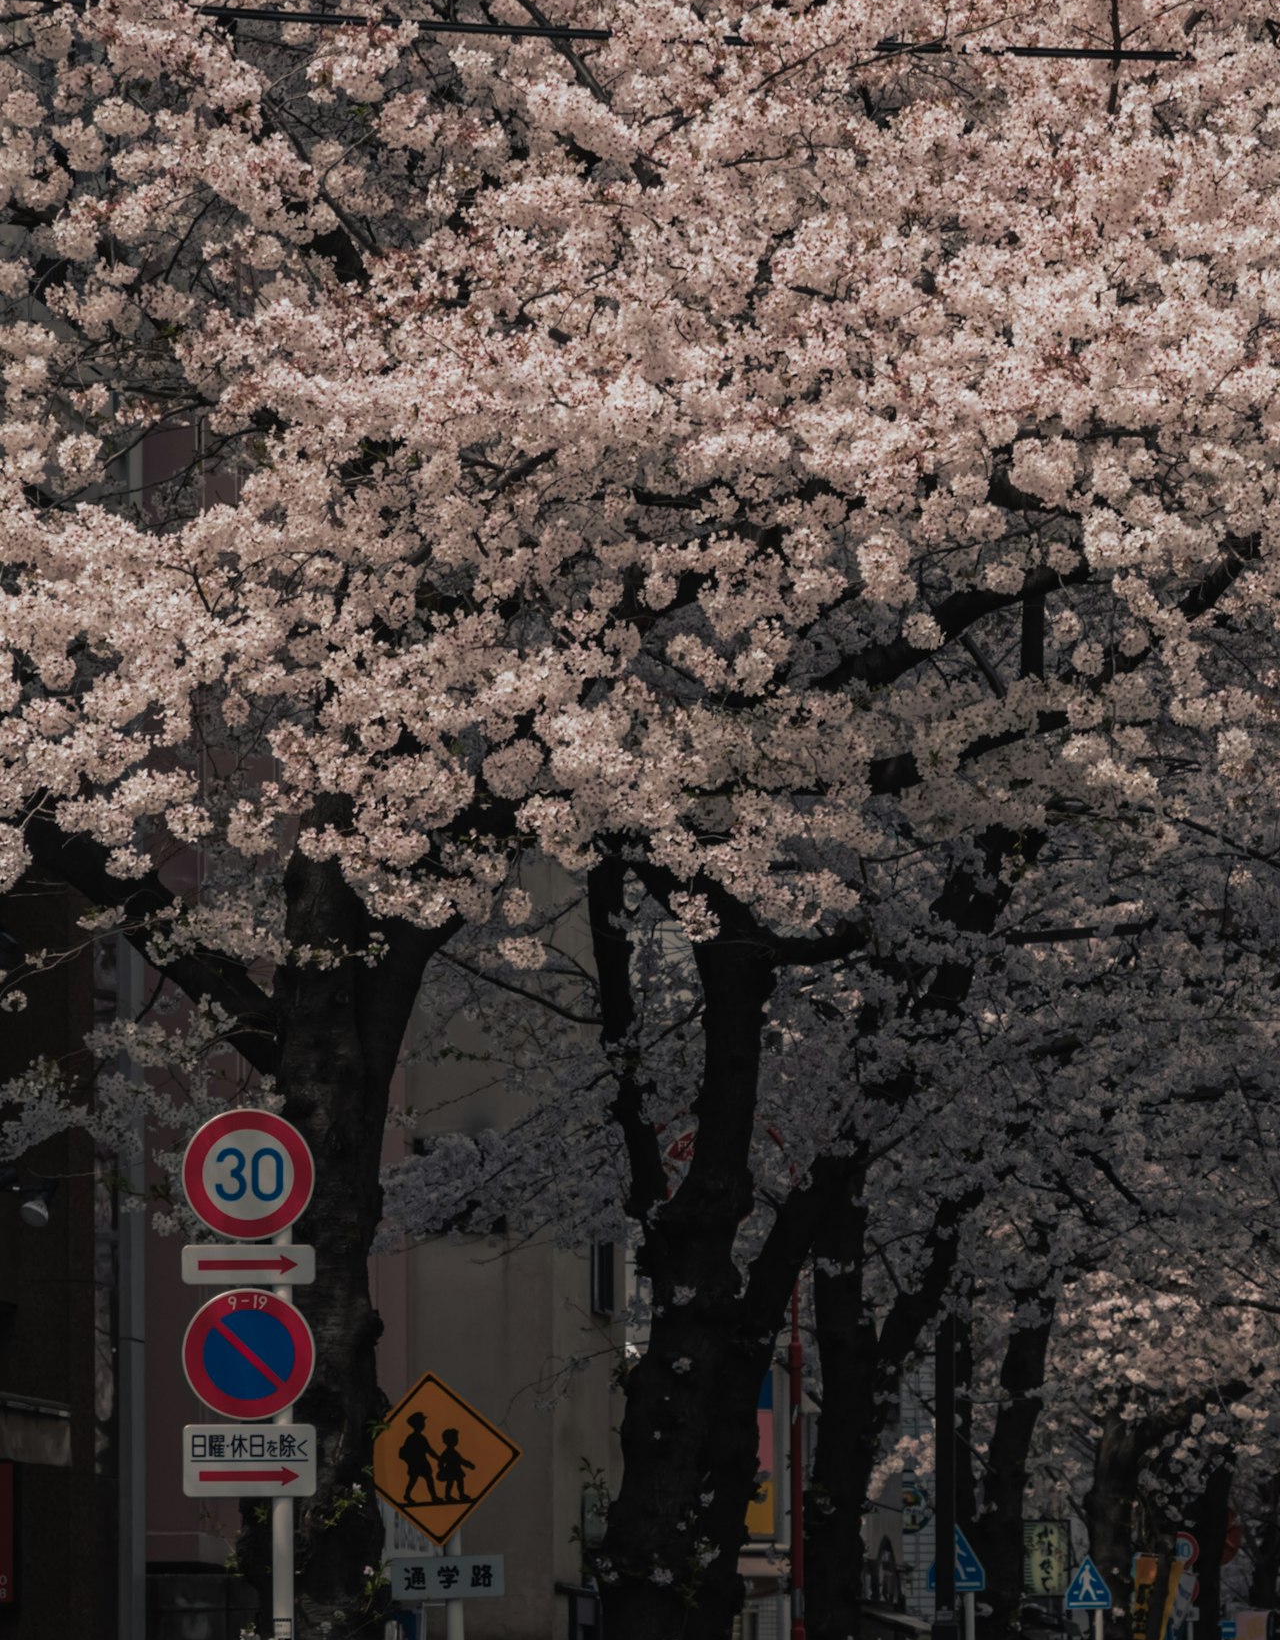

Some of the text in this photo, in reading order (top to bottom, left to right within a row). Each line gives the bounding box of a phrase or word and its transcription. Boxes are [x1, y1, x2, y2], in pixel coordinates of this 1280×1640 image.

[215, 1147, 284, 1202] 30
[228, 1295, 268, 1311] 9-19
[403, 1565, 494, 1591] 通学路
